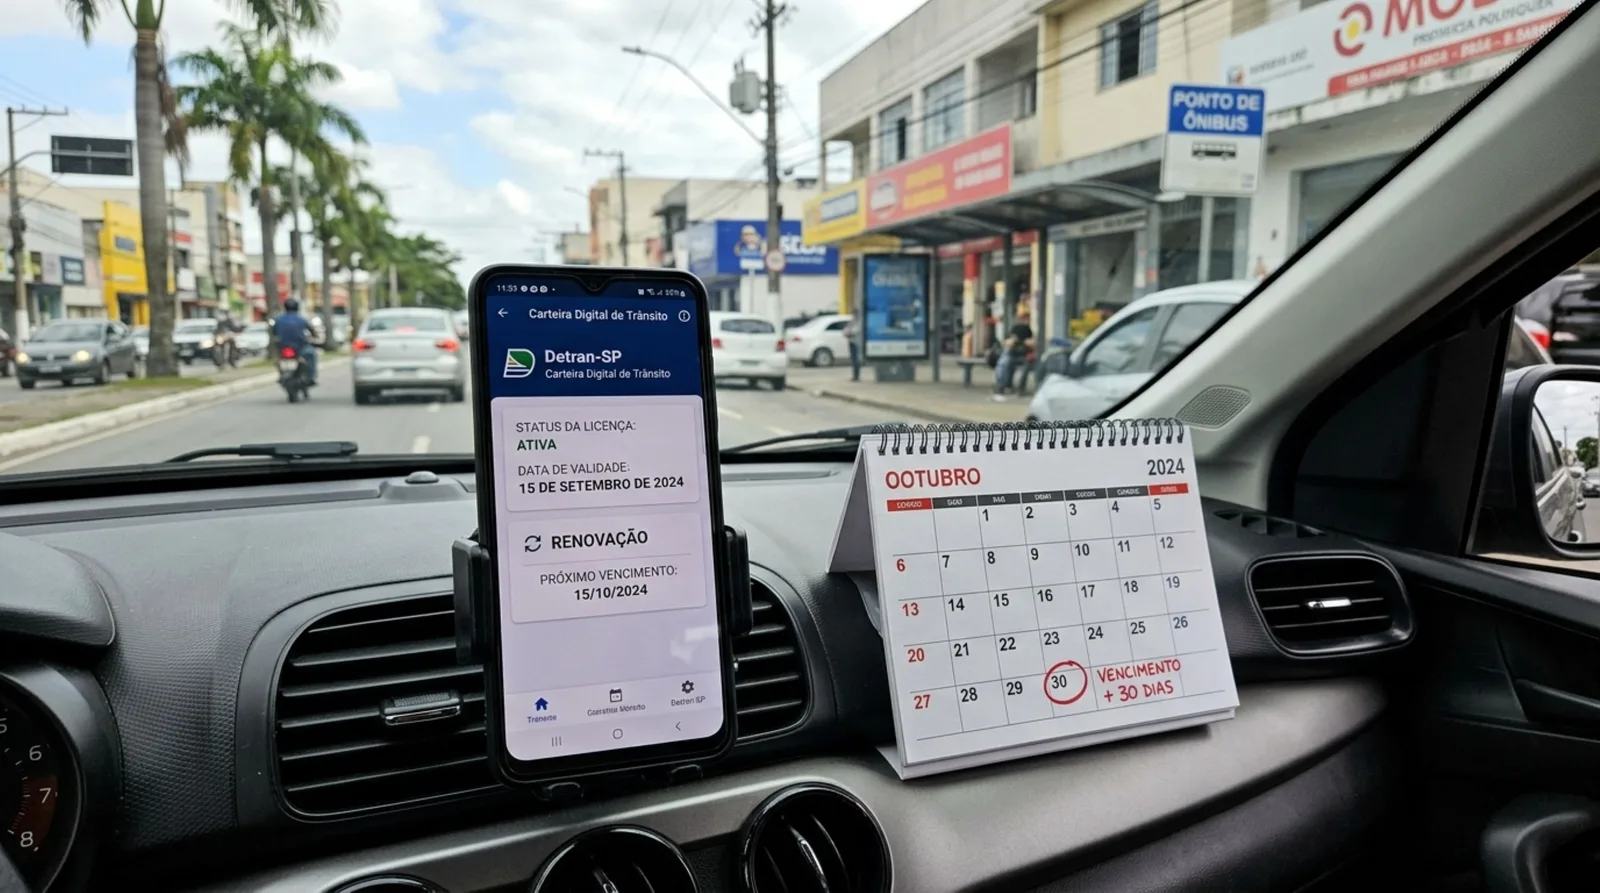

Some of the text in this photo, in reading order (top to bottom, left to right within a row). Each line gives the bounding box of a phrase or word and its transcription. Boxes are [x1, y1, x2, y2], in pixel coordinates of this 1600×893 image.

[1173, 91, 1261, 111] PONTO DE
[1182, 110, 1249, 131] ÔNIBUS
[529, 309, 668, 322] Carteira Digital de Trânsito
[545, 350, 622, 364] Detran-SP
[545, 369, 671, 380] Carteira Digital de Trânsito
[516, 420, 637, 433] STATUS DA LICENÇA:
[516, 439, 557, 451] ATIVA
[518, 462, 631, 476] DATA DE VALIDADE:
[885, 458, 1185, 490] OOTUBRO 2024
[519, 476, 684, 494] 15 DE SETEMBRO DE 2024
[983, 498, 1161, 521] 1 2 3 4 5
[551, 528, 648, 549] RENOVAÇÃO
[896, 536, 1174, 572] 6 7 8 9 10 11 12
[540, 565, 678, 585] PRÓXIMO VENCIMENTO:
[574, 584, 648, 601] 15/10/2024
[902, 575, 1181, 617] 13 14 15 16 17 18 19
[907, 615, 1189, 663] 20 21 22 23 24 25 26
[1096, 658, 1182, 684] VENCIMENTO
[913, 674, 1067, 710] 27 28 29 30
[1119, 685, 1139, 702] 30
[1142, 679, 1175, 698] DIAS
[29, 744, 43, 761] 6
[39, 787, 52, 804] 7
[19, 831, 34, 848] 8
